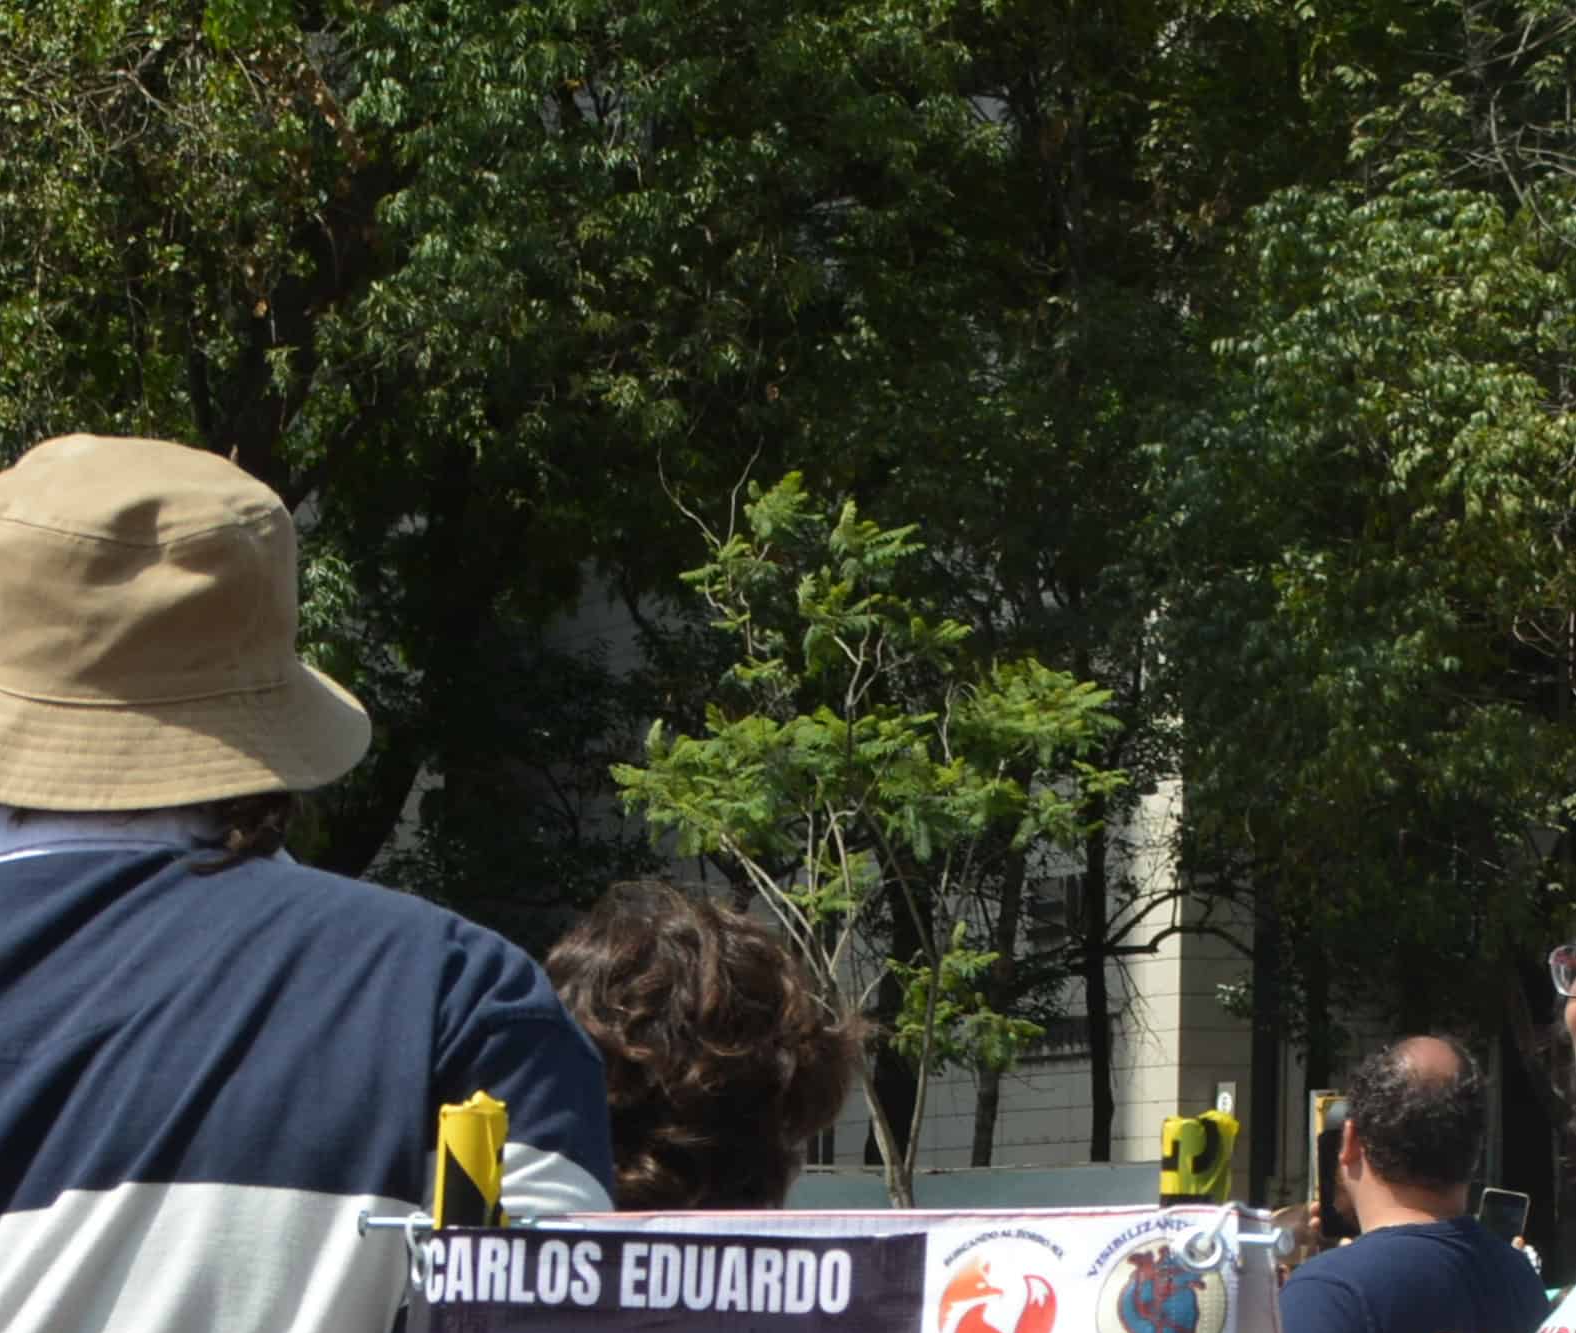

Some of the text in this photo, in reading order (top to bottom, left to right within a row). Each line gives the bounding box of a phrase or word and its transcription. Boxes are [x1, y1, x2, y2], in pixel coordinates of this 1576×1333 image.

[427, 1238, 851, 1314] CARLOS EDUARDO
[1087, 1216, 1190, 1278] VISIBILIZAND
